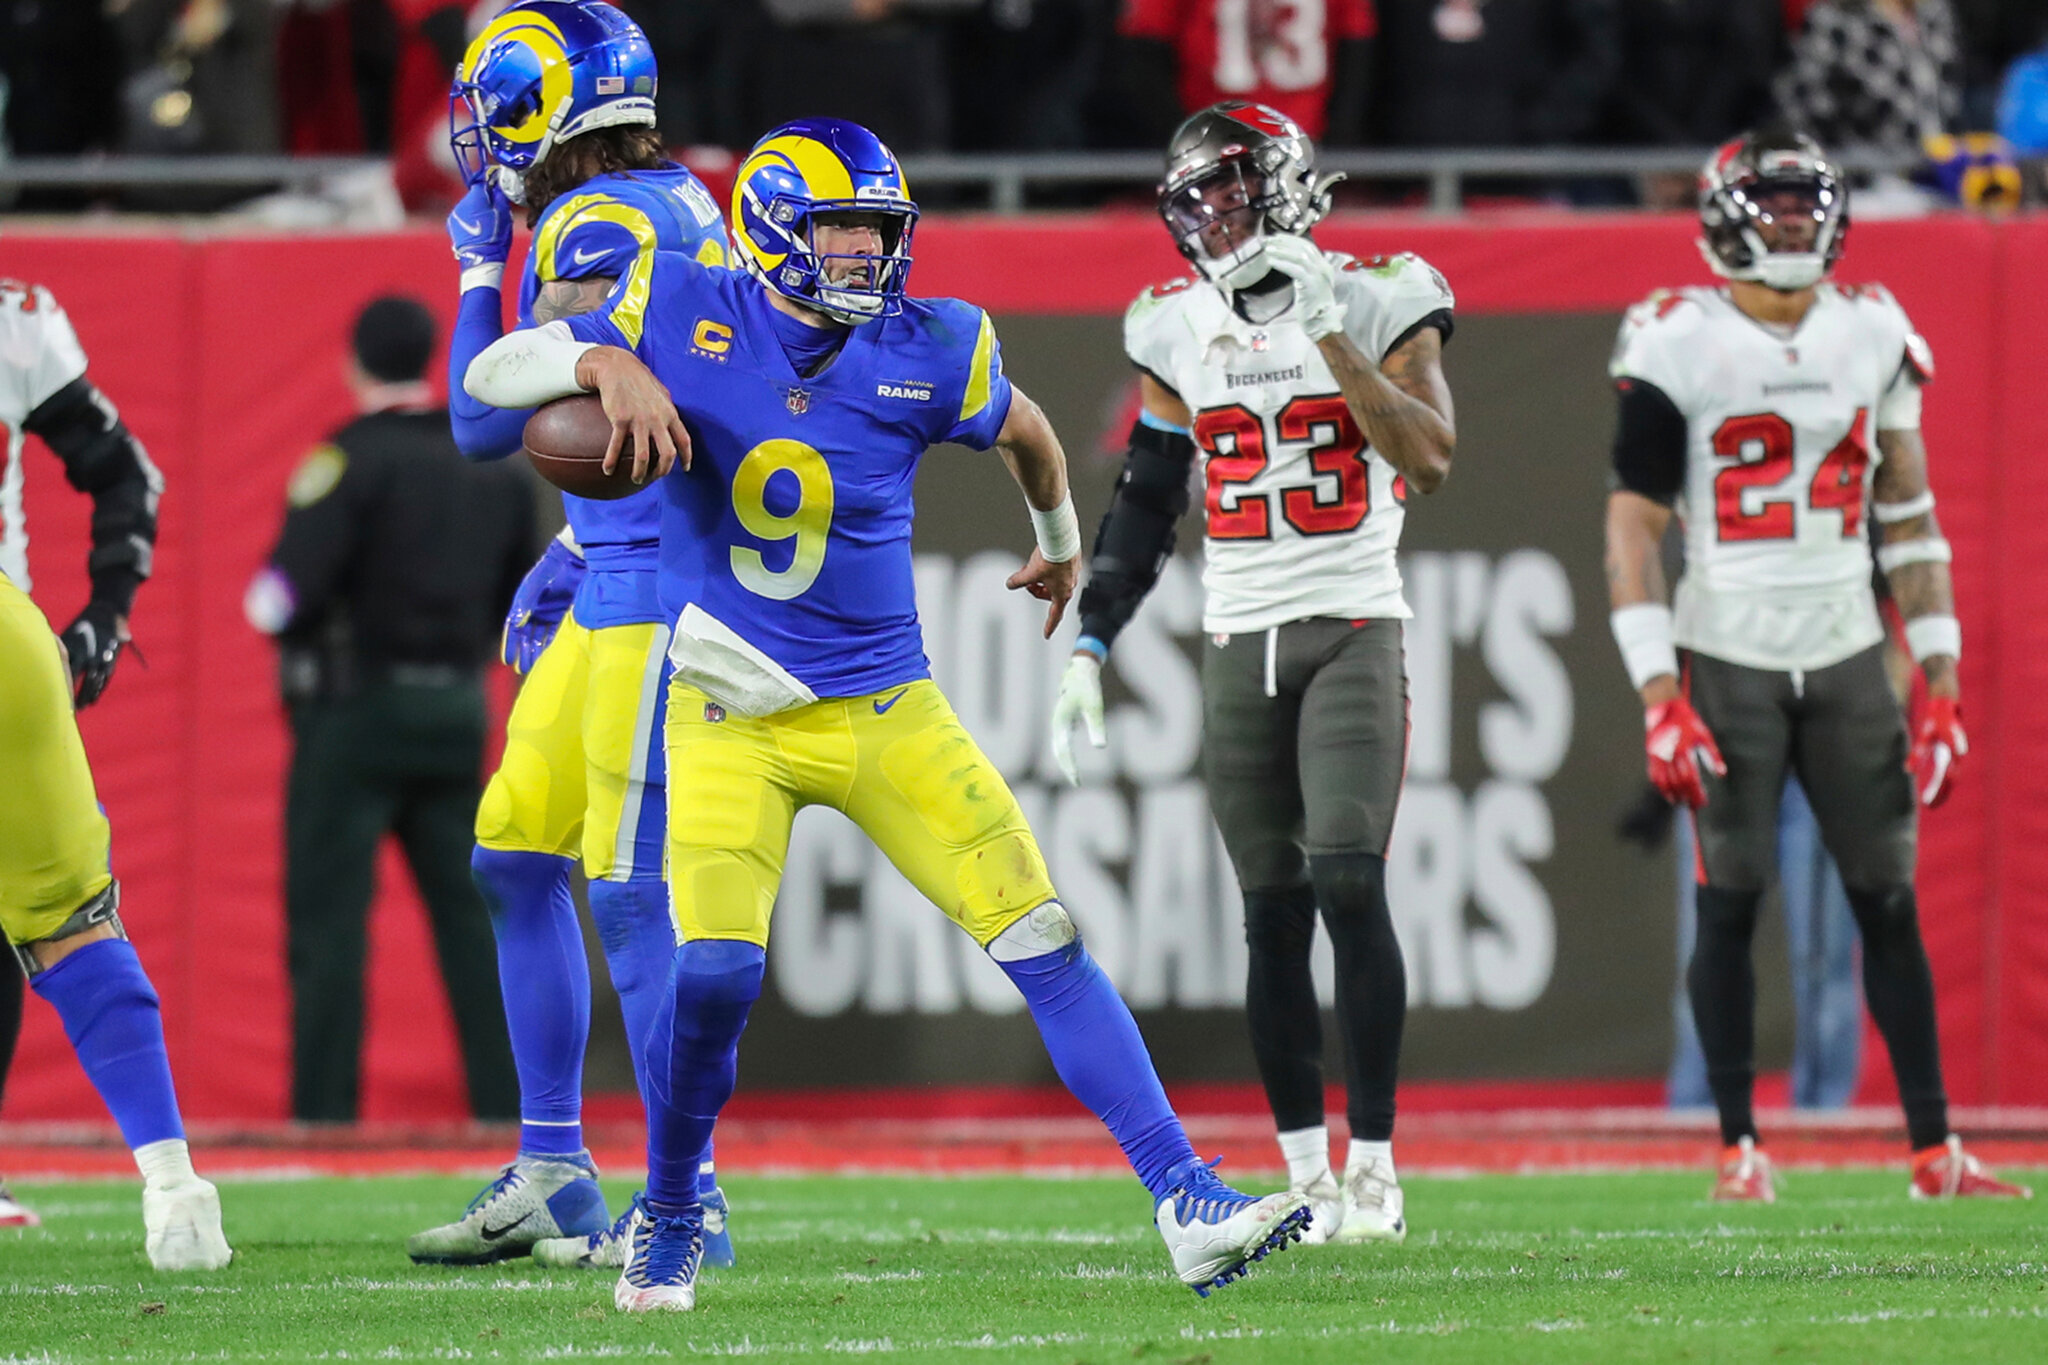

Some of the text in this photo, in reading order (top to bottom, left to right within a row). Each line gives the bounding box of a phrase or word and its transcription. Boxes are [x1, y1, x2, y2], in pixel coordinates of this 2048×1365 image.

[1213, 0, 1328, 92] 13
[693, 319, 733, 353] C
[877, 385, 932, 401] RAMS
[1226, 364, 1304, 390] BUCCANEERS
[730, 437, 835, 601] 9
[1194, 391, 1371, 541] 23
[1712, 406, 1868, 543] 24
[772, 776, 1557, 1017] CRSARS
